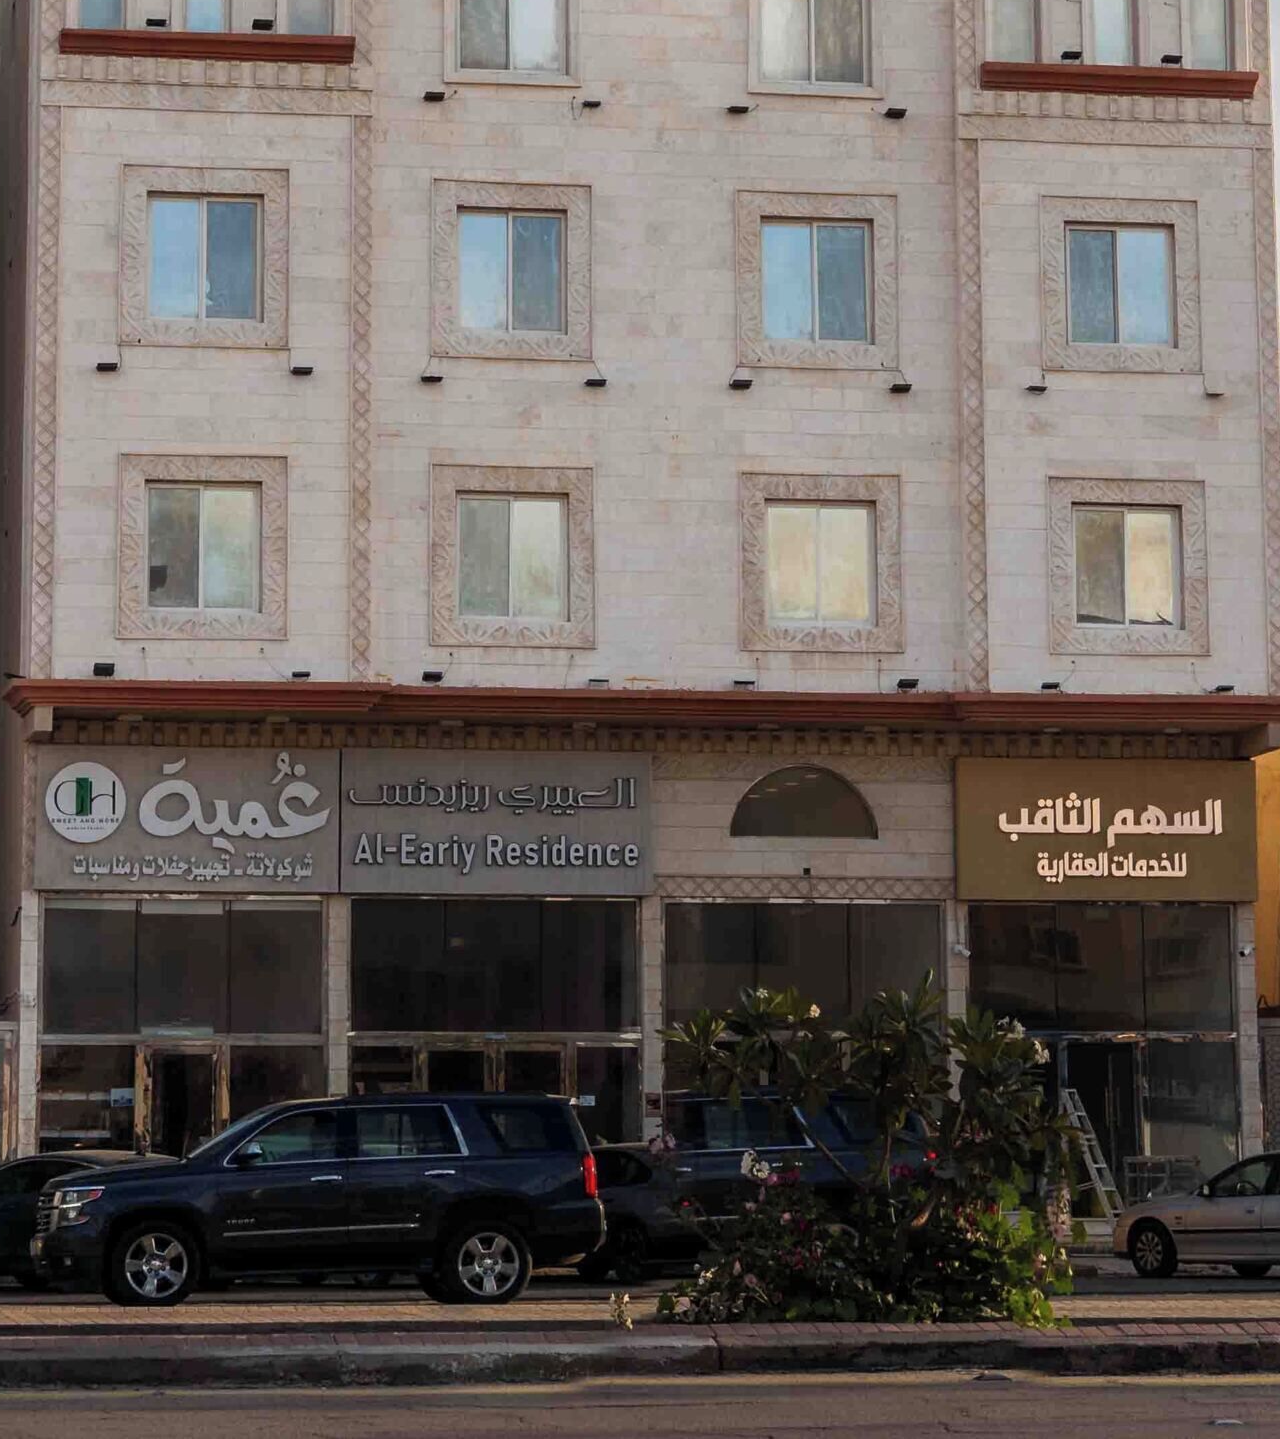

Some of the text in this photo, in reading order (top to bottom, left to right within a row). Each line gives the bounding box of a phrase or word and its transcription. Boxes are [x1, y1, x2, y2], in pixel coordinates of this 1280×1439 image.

[998, 792, 1223, 849] السهم الثاقب
[142, 853, 189, 877] حفلات
[186, 854, 231, 882] تجهيز
[246, 852, 313, 882] شوكولاتة
[354, 833, 639, 874] Al-Eariy Residence
[1037, 851, 1187, 883] للخدمات العقارية
